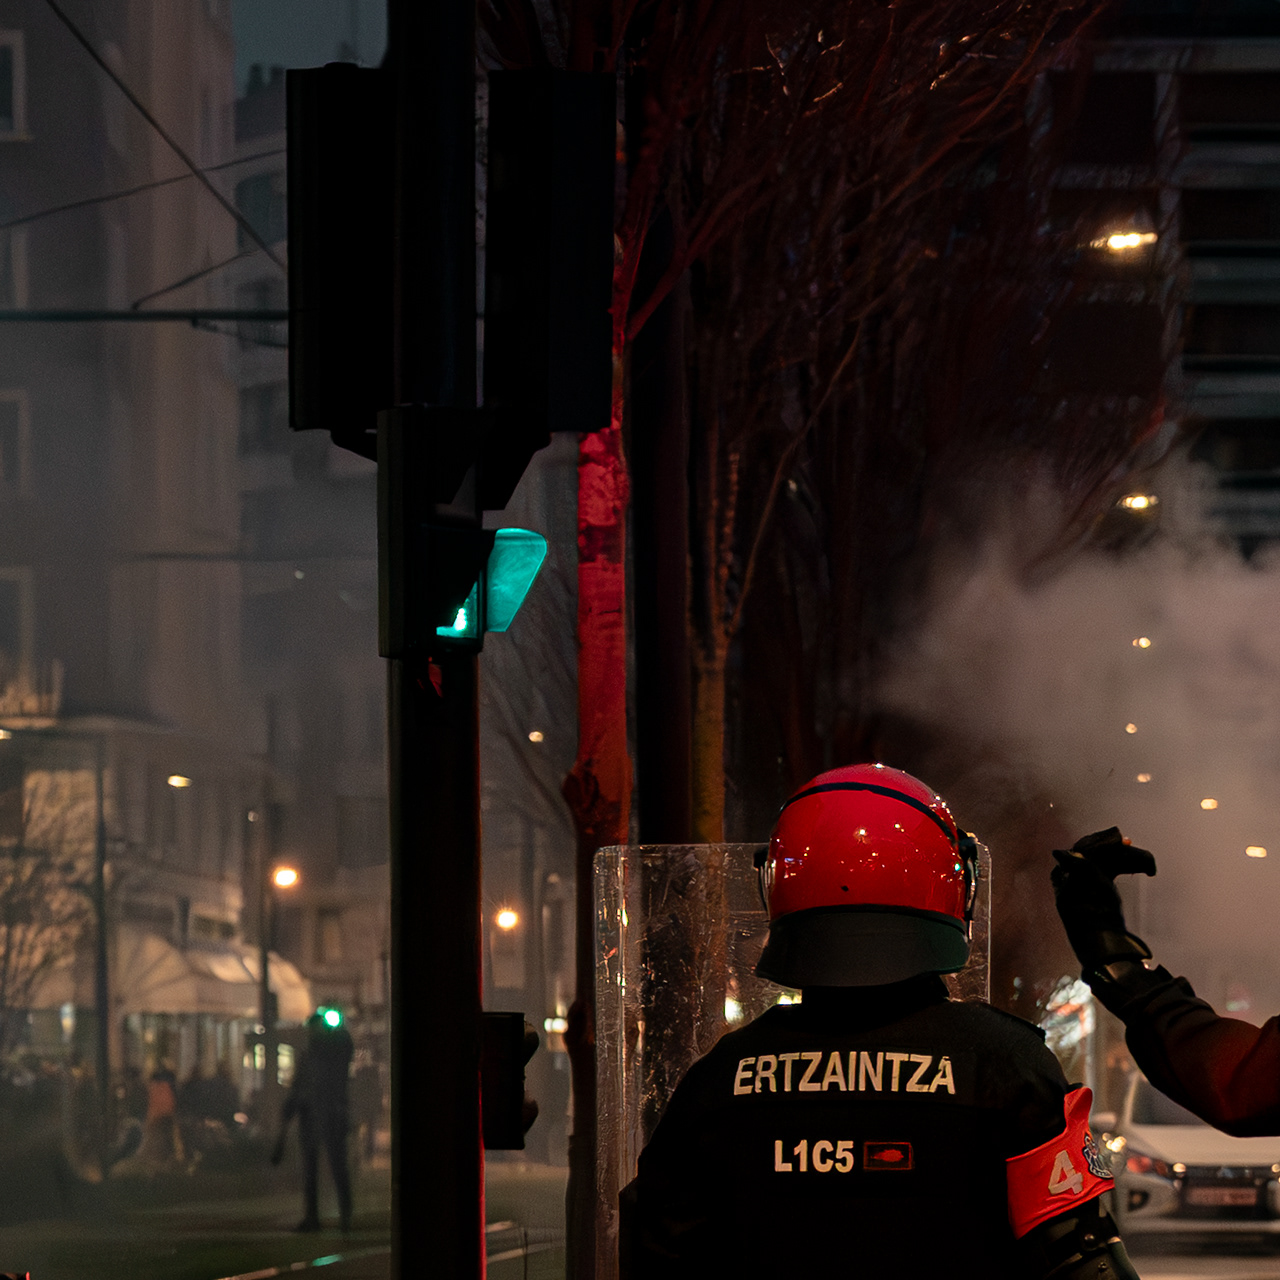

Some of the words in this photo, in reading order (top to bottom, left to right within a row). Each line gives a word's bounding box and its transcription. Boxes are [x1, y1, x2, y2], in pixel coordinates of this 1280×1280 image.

[733, 1051, 956, 1096] ERTZAINTZA
[774, 1139, 854, 1173] L1C5
[1048, 1149, 1084, 1196] 4
